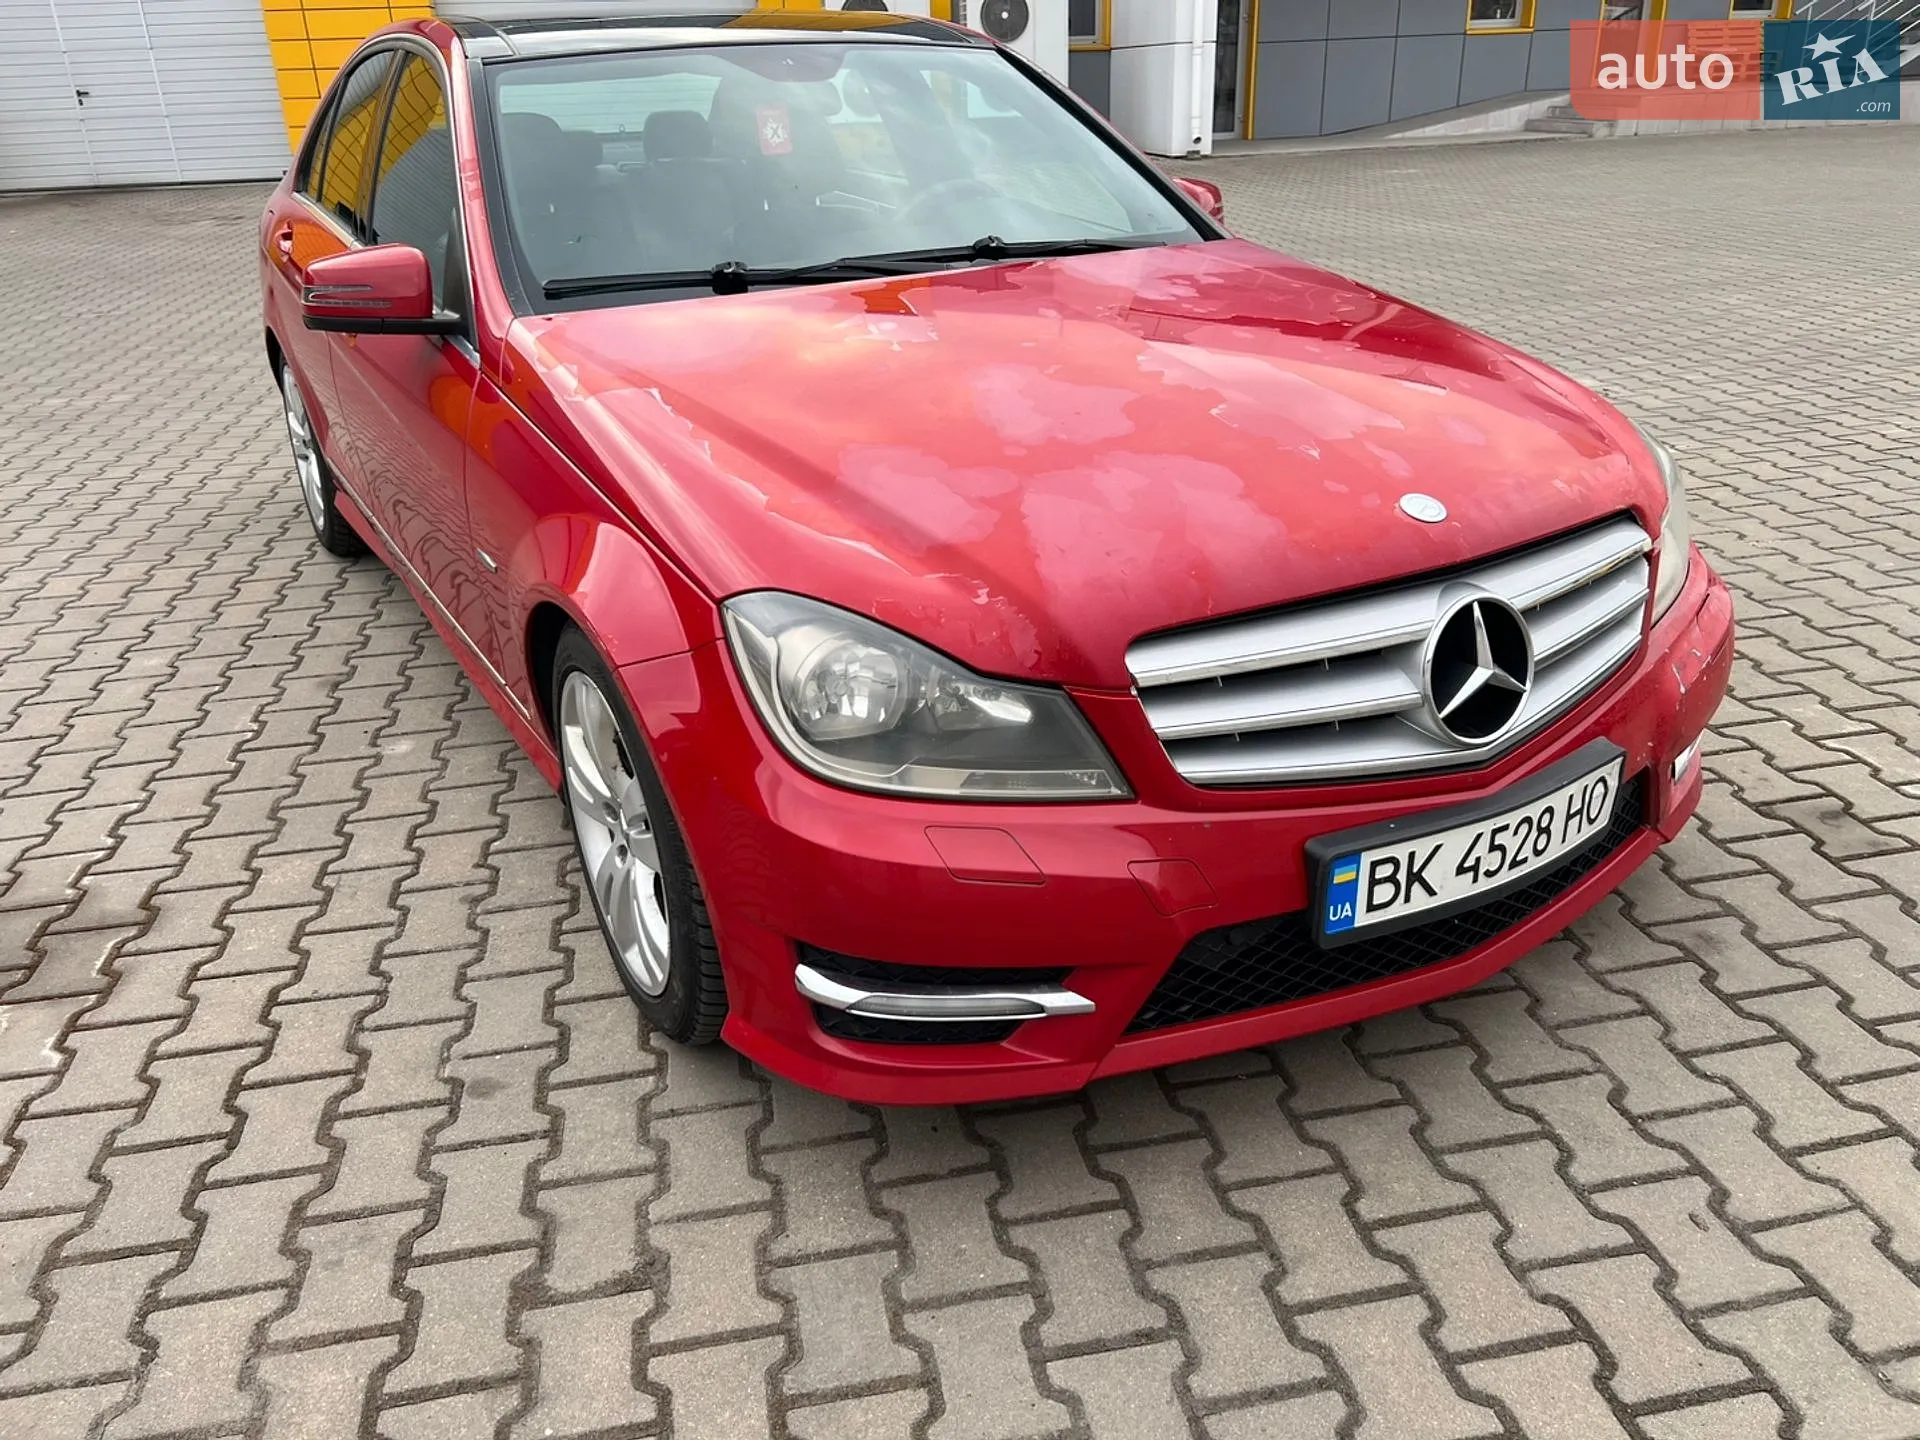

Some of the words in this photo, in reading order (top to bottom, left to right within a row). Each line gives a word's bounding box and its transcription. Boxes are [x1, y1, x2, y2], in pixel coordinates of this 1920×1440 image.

[1365, 843, 1444, 913] BK
[1455, 805, 1554, 884] 4528
[1561, 775, 1608, 844] HO
[1329, 902, 1353, 921] UA
